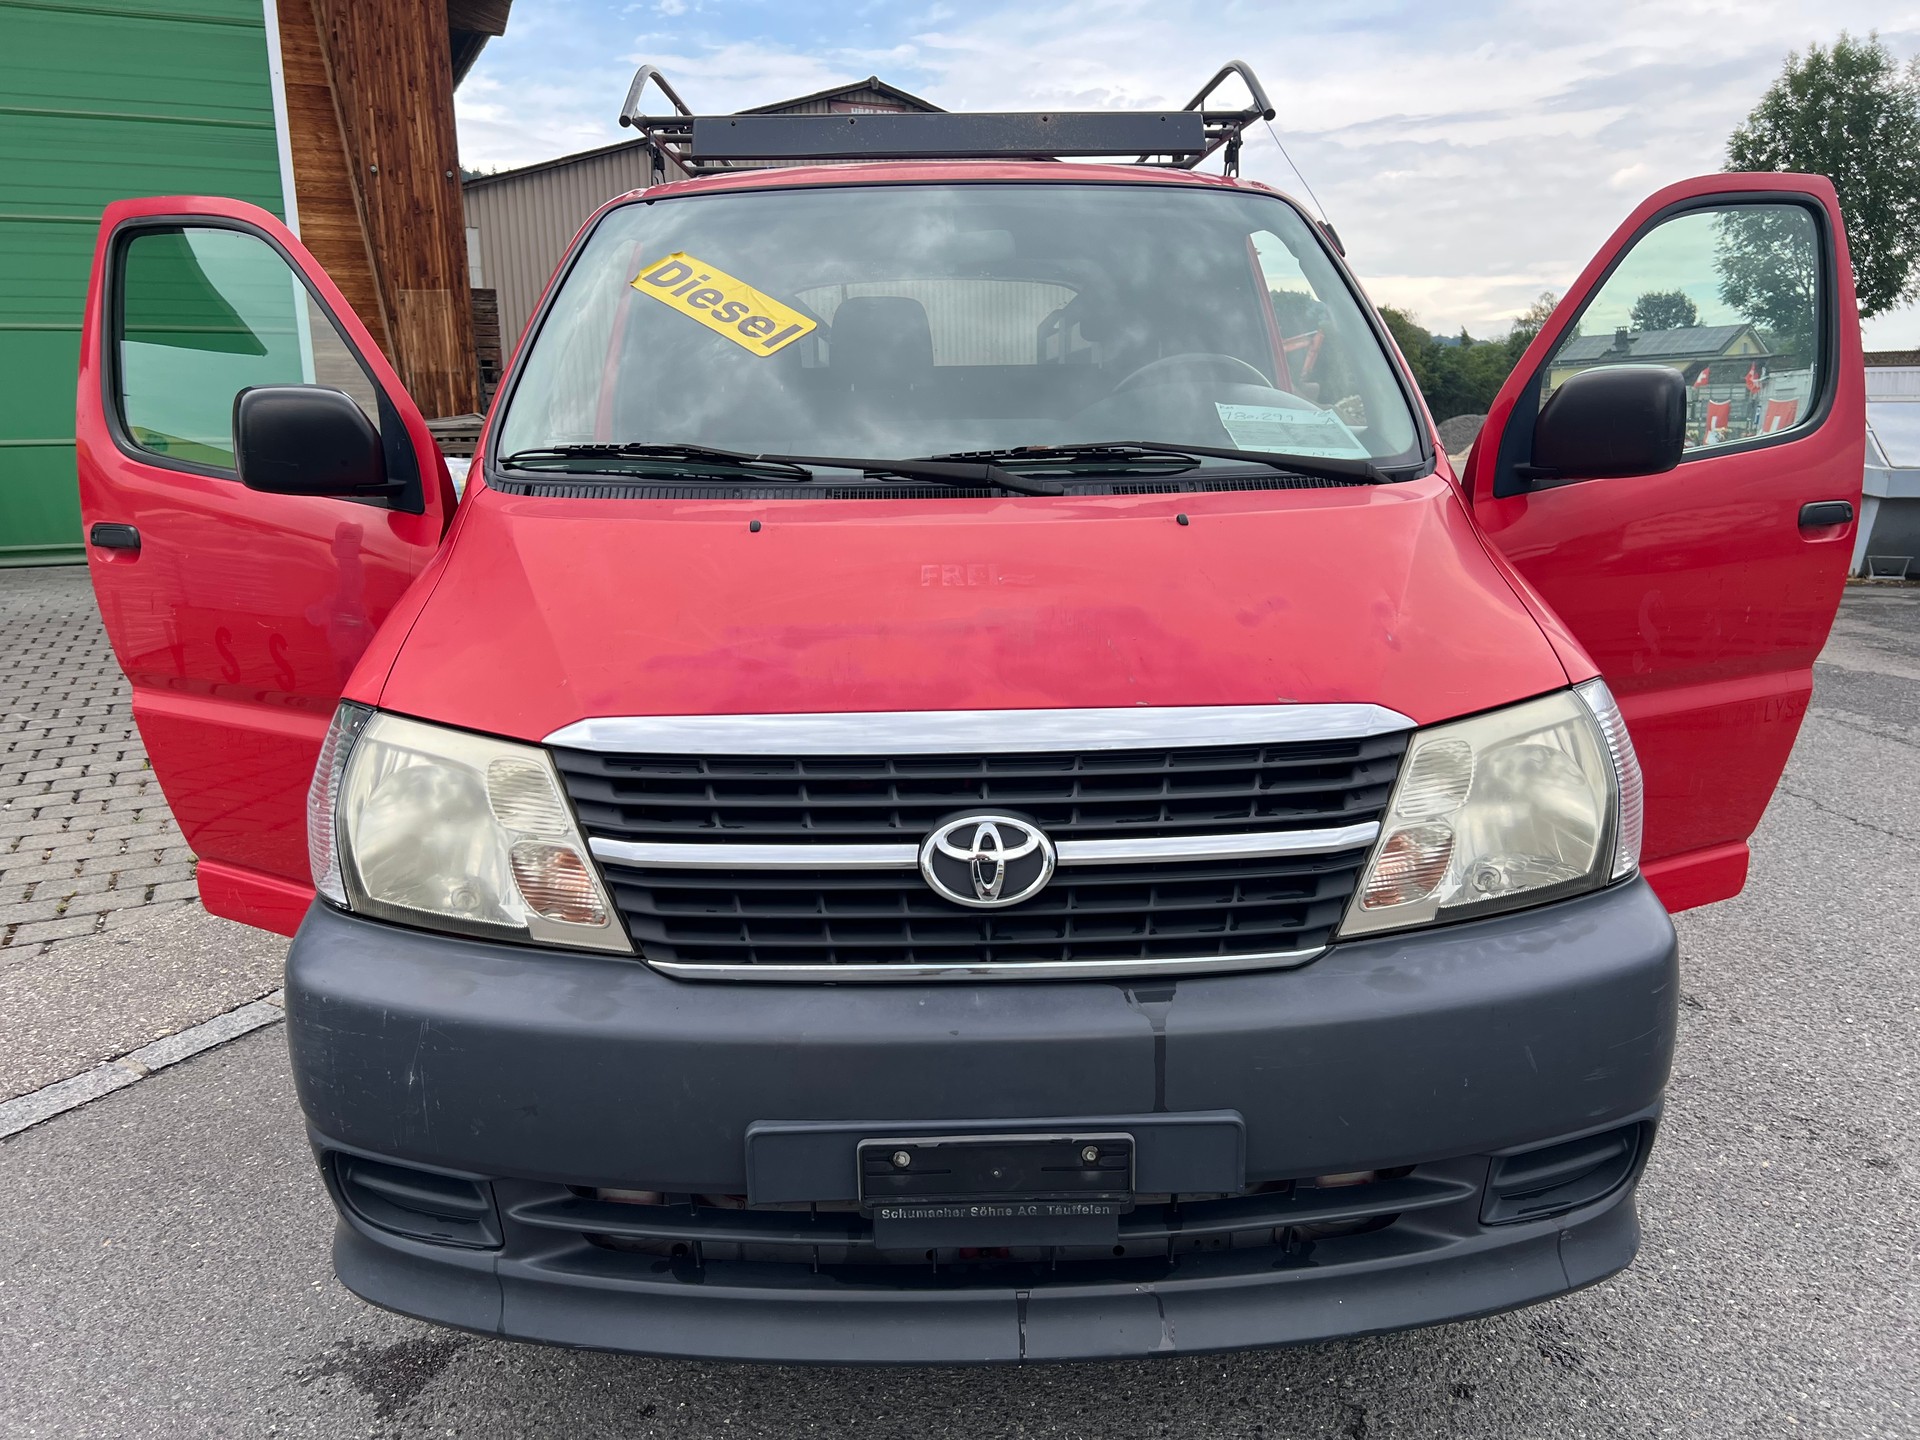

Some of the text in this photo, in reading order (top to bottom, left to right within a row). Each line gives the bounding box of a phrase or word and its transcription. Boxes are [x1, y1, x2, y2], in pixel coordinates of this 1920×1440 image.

[642, 260, 804, 349] Diesel
[881, 1204, 1110, 1219] Schumacher Söhne AG Täuffelen
